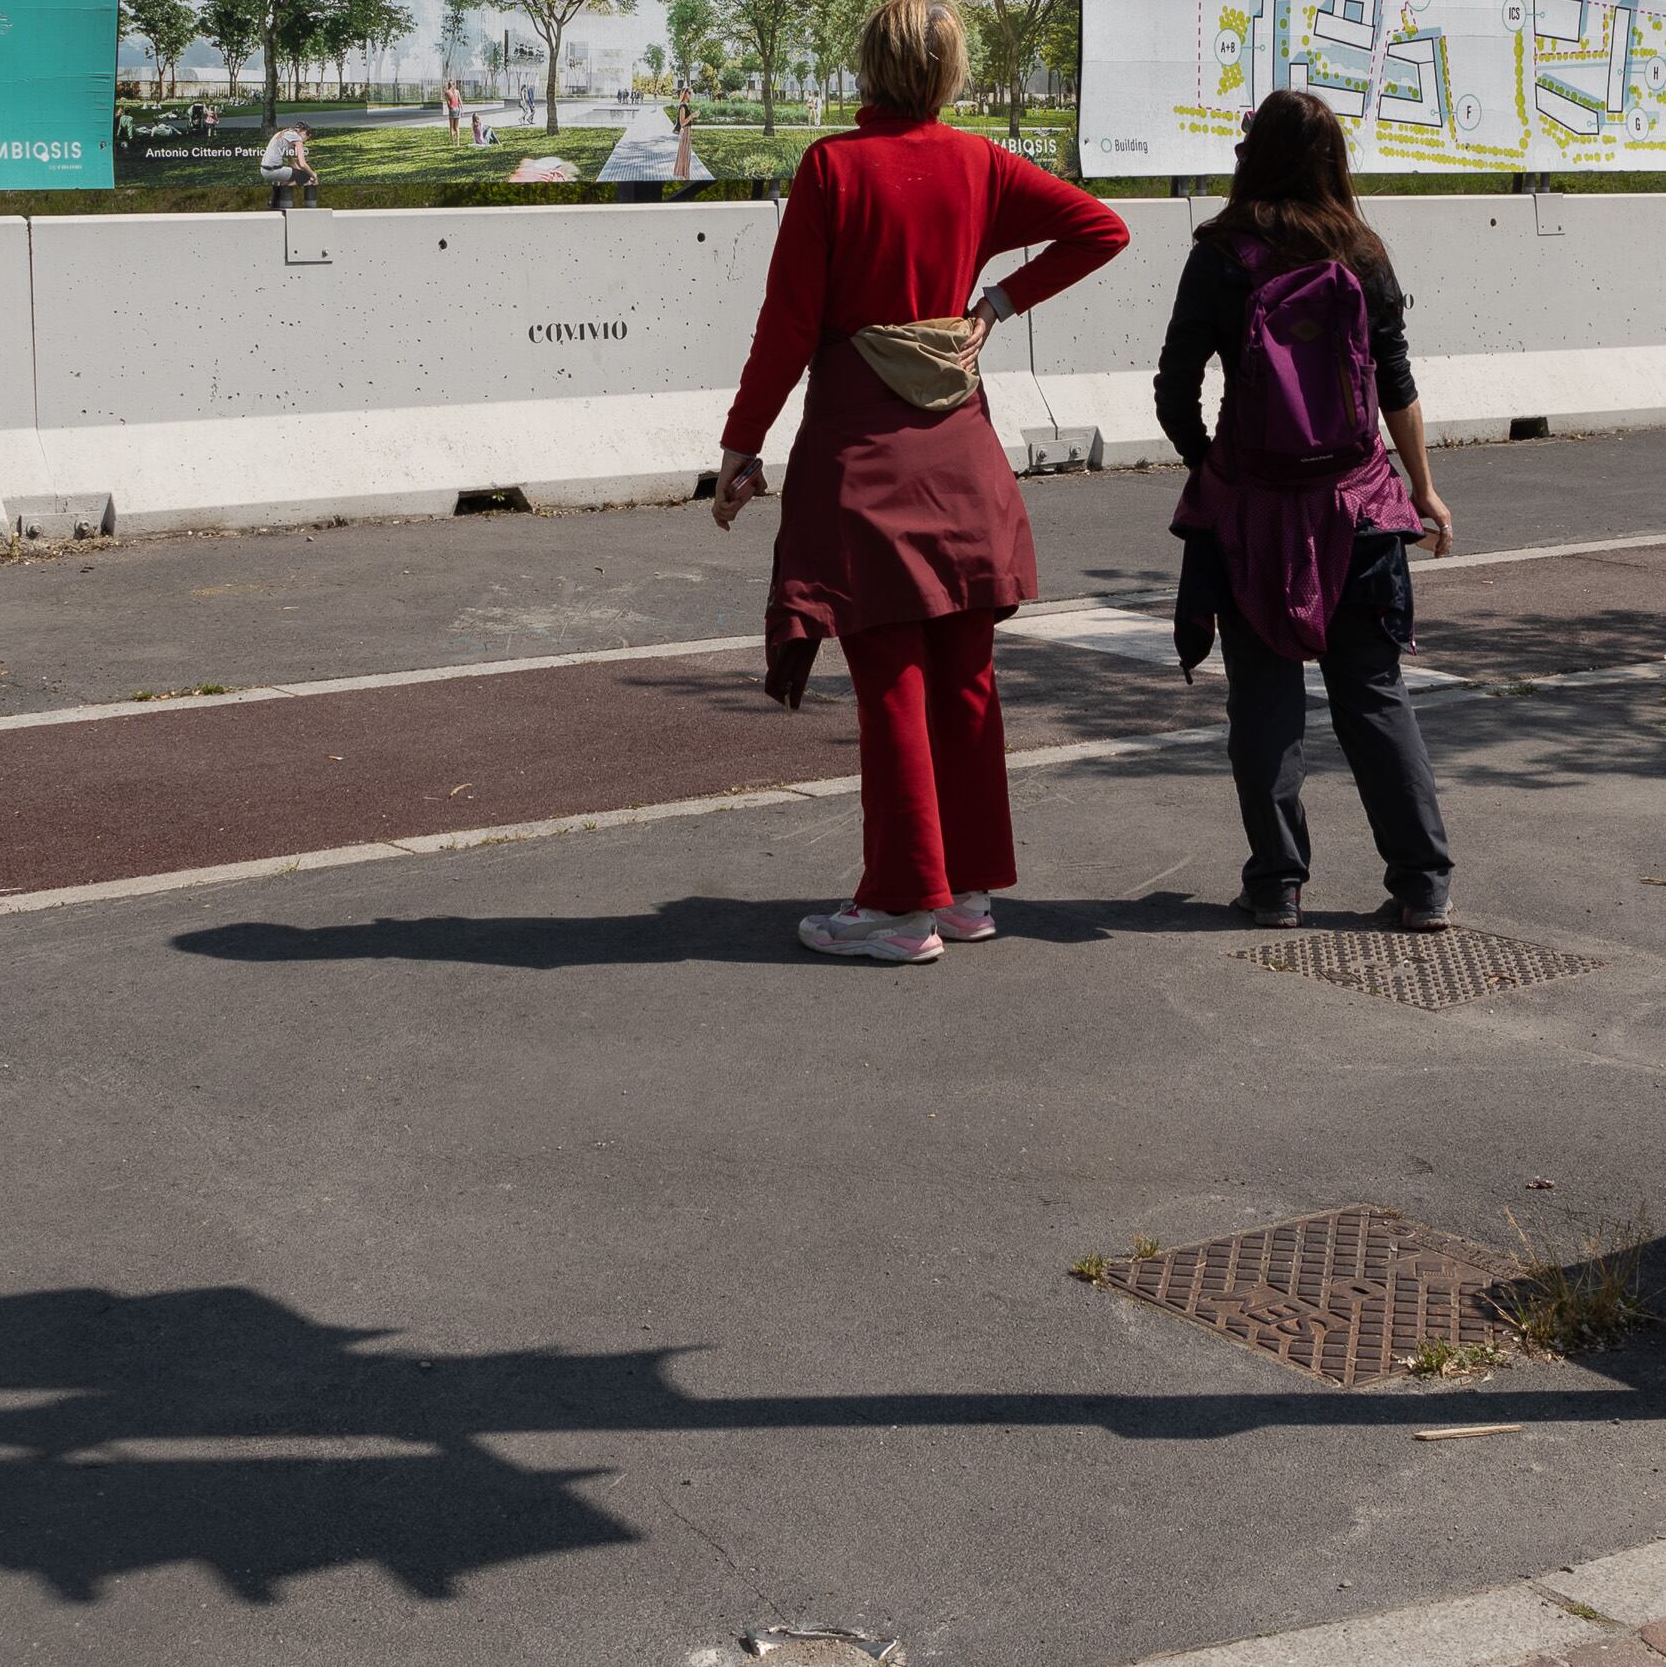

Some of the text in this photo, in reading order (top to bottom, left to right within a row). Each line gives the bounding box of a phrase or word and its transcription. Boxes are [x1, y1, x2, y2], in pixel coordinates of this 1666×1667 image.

[1508, 7, 1521, 21] ICS
[1220, 41, 1236, 53] A+B
[1653, 66, 1659, 80] H
[1466, 105, 1472, 119] F
[1635, 117, 1641, 131] G
[145, 146, 190, 158] Antonio
[191, 146, 232, 158] Citterio
[1114, 138, 1149, 154] Building
